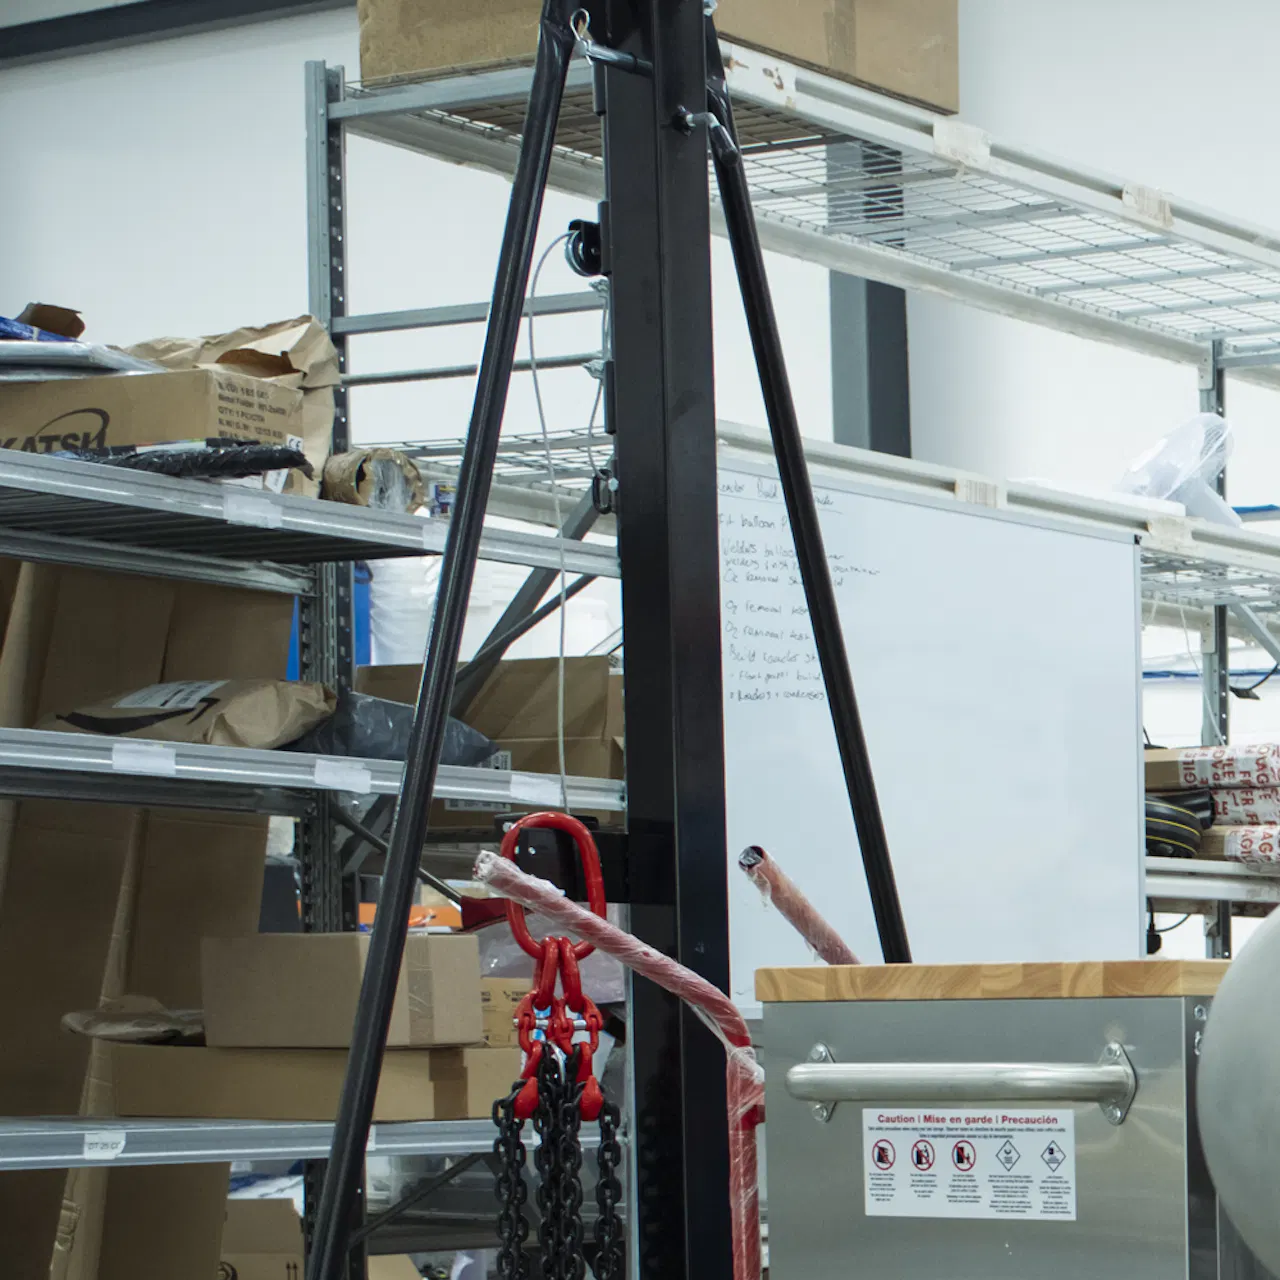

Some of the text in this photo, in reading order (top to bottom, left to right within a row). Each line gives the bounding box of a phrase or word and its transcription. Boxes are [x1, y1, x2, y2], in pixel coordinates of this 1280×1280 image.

[877, 1114, 915, 1124] Caution
[923, 1114, 947, 1124] Mise
[965, 1115, 993, 1126] garde
[1001, 1115, 1058, 1125] Precaución
